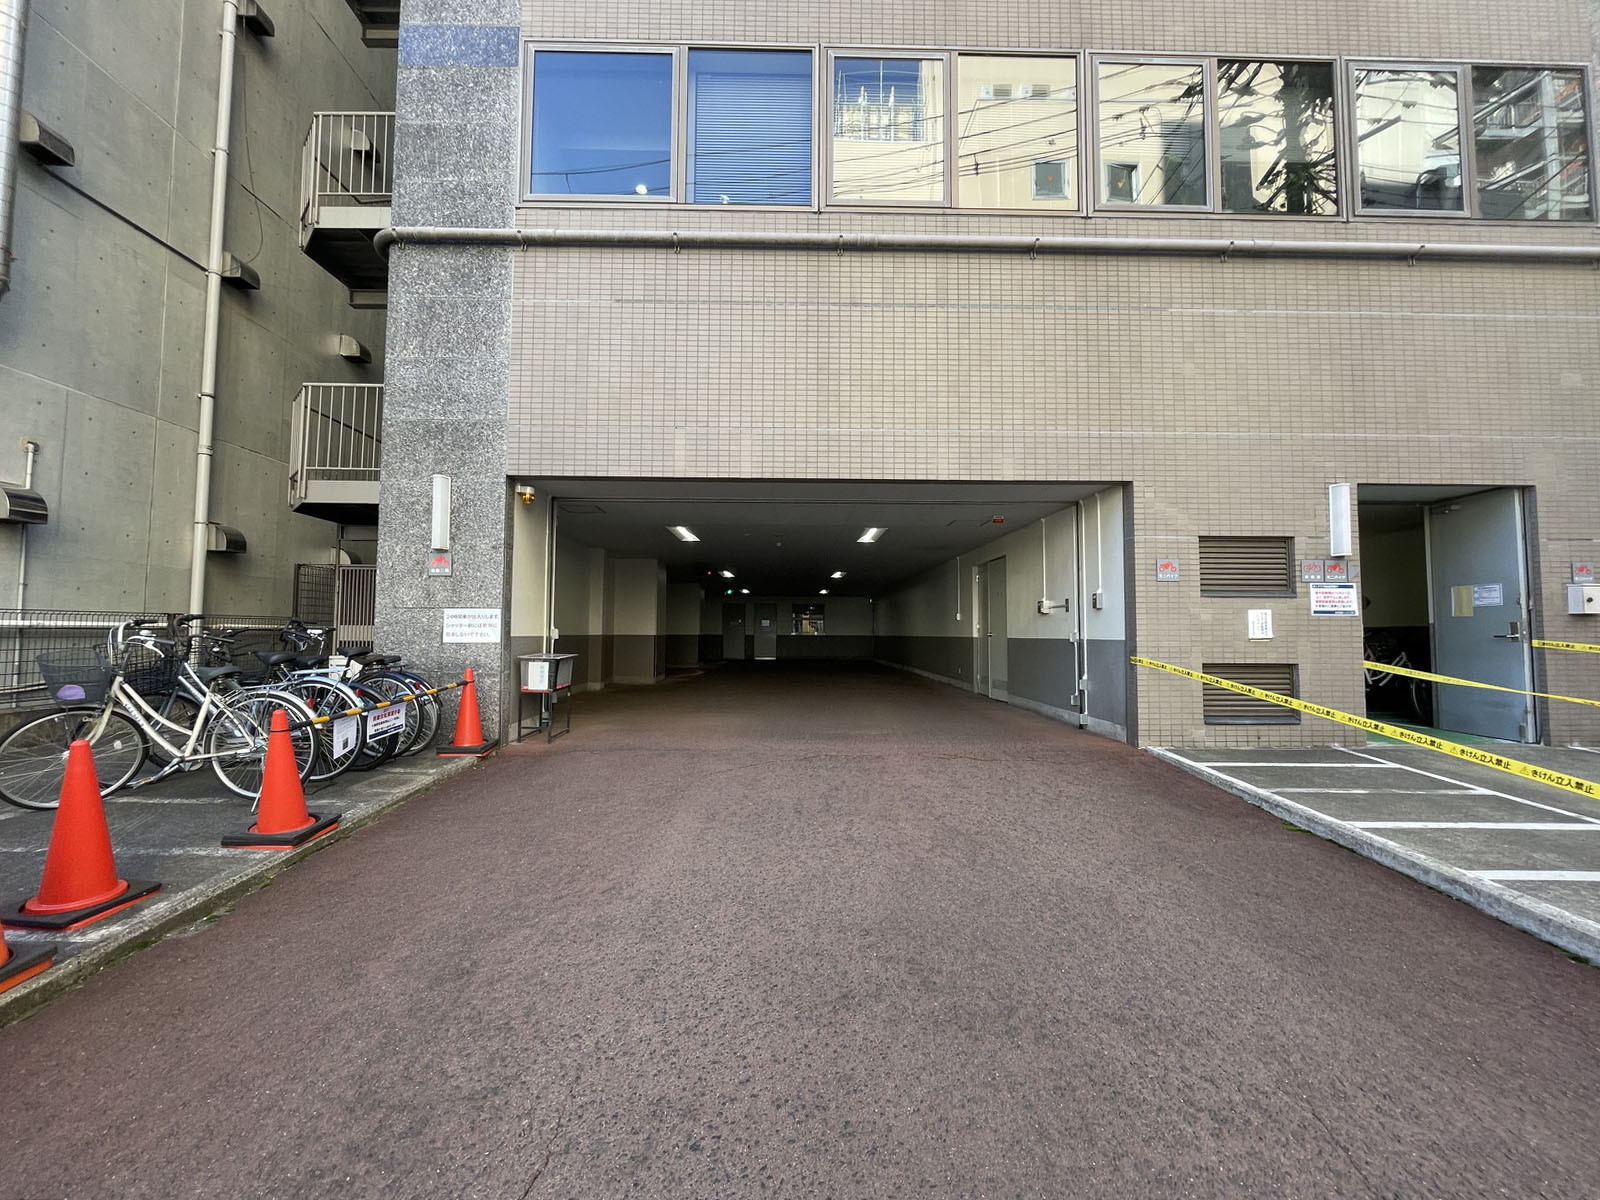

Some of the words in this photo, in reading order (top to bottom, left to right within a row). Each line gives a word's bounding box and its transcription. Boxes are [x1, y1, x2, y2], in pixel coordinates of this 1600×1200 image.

[1303, 704, 1336, 719] きけん立入禁止
[1347, 716, 1385, 733] きけん立入禁止
[1399, 730, 1443, 750] きけん立入禁止
[1459, 747, 1512, 770] きけん立入禁止
[1530, 768, 1595, 795] きけん立入禁止
